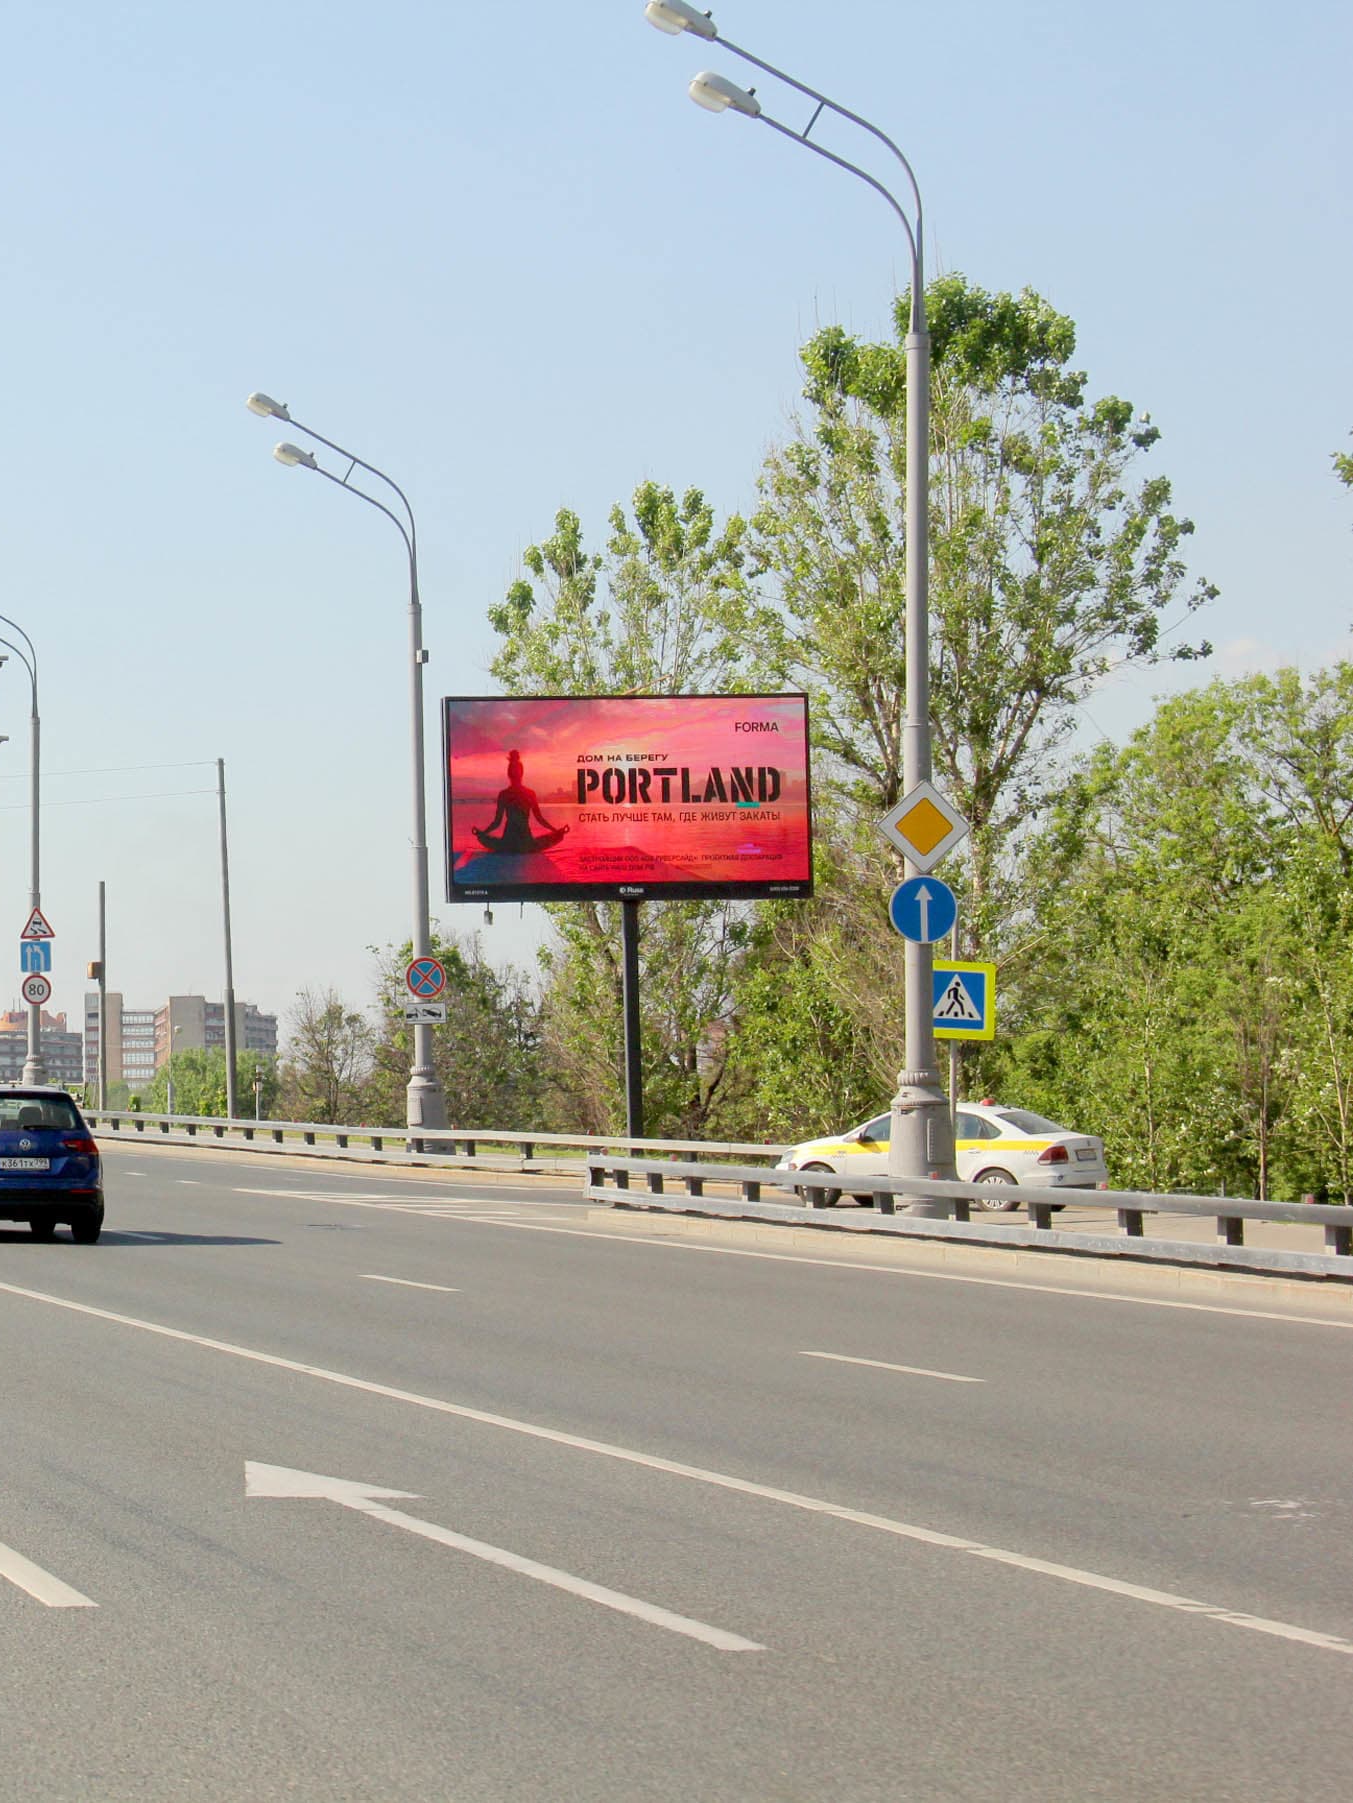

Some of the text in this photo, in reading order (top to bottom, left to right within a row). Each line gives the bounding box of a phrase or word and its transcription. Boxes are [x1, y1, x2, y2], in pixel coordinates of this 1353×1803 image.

[735, 722, 779, 732] FORMA
[577, 755, 603, 763] ДОМ
[577, 767, 780, 804] PORTLAND
[578, 811, 780, 823] СТАТЬ ЛУЧШЕ ТАМ, ГДЕ ЖИВУТ ЗАКАТЫ
[28, 983, 45, 996] 80
